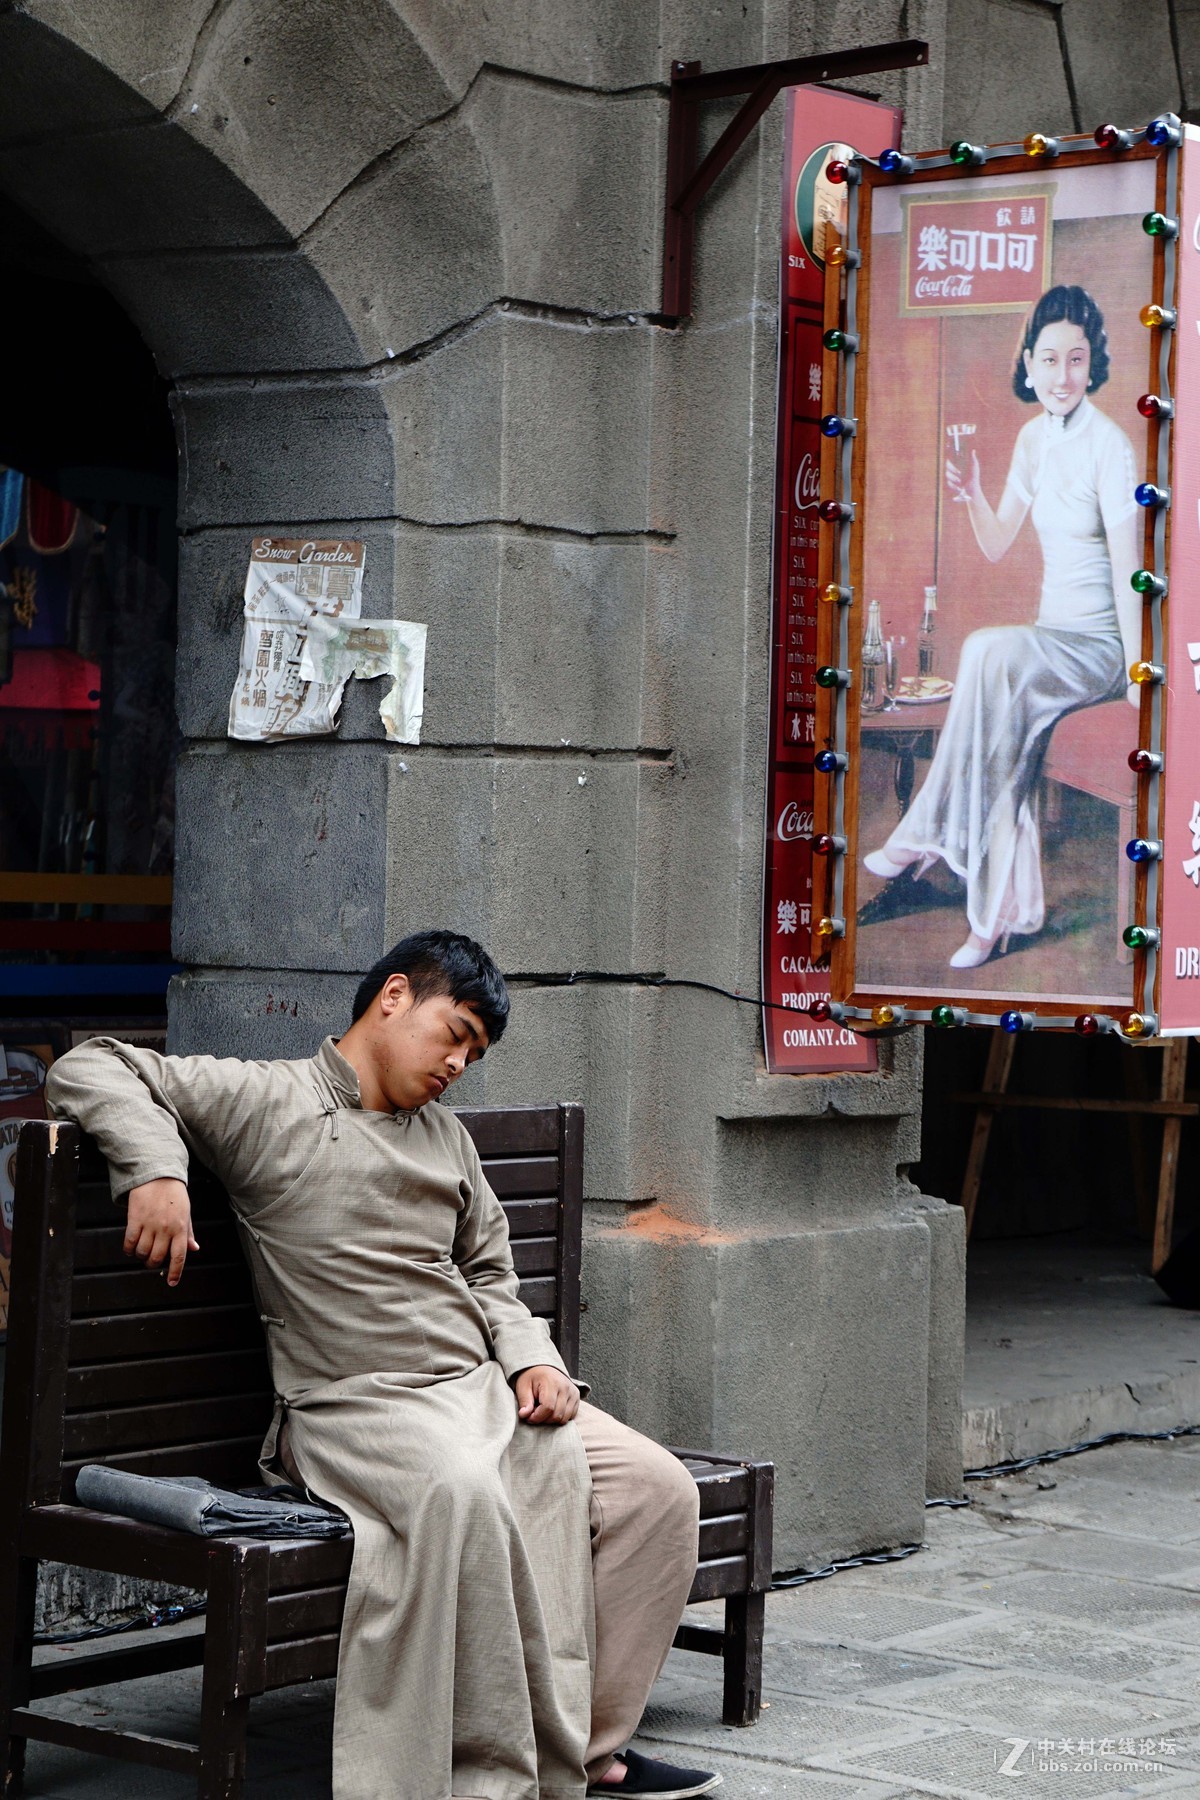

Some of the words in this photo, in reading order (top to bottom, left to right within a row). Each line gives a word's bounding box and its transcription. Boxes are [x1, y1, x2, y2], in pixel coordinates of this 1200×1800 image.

[788, 255, 806, 269] SIX
[255, 539, 297, 559] Snow
[300, 542, 357, 564] Garden
[1175, 947, 1200, 977] DR
